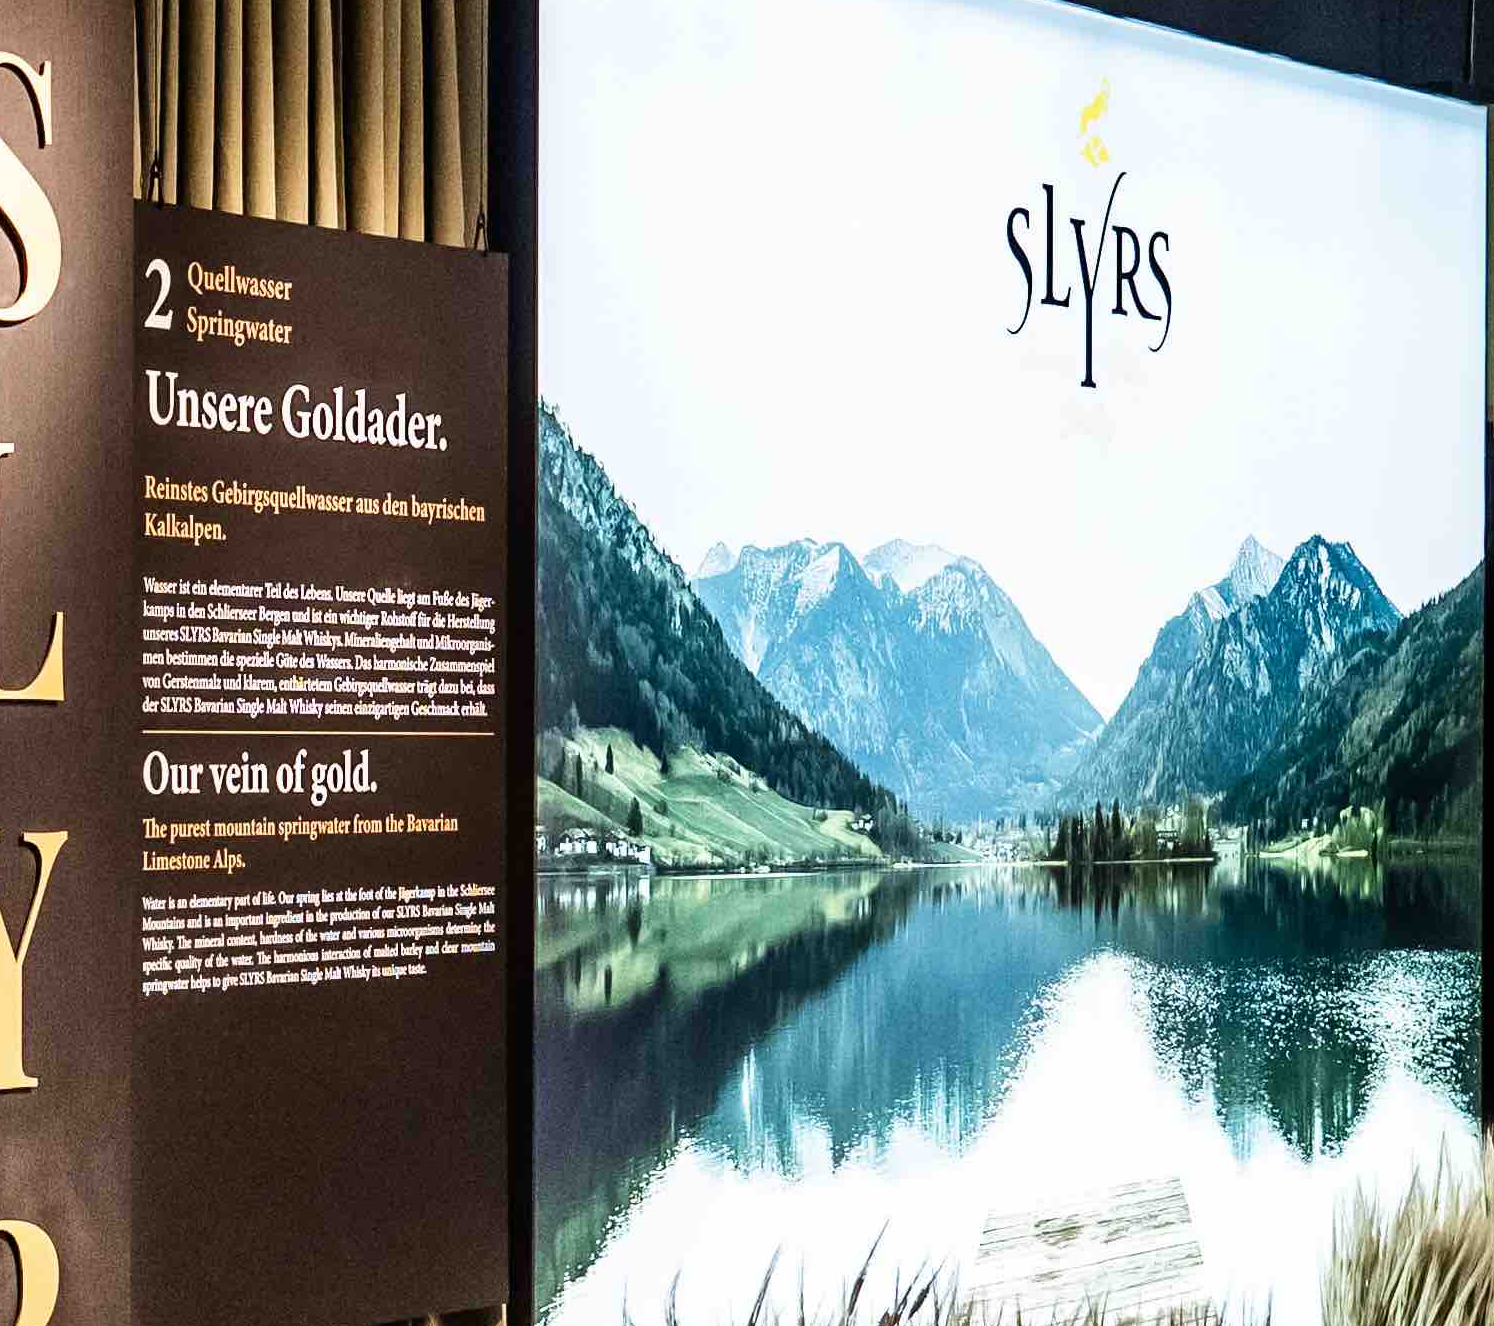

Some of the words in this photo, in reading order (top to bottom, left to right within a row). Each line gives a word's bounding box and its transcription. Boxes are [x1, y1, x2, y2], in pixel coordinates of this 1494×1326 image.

[145, 259, 173, 330] 2
[188, 261, 292, 301] Quellwasser
[1006, 171, 1172, 388] SLYRS
[187, 306, 292, 347] Springwater
[146, 369, 272, 435] Unsere
[282, 384, 447, 451] Goldader.
[145, 475, 208, 503] Reinstes
[212, 480, 353, 515] Gebirgsquellwasser
[356, 498, 379, 515] aus
[382, 492, 408, 517] den
[412, 494, 484, 526] bayrischen
[145, 512, 226, 546] Kalkalpen.
[143, 750, 203, 795] Our
[209, 751, 269, 795] vein
[276, 748, 307, 794] of
[311, 748, 377, 807] gold.
[143, 817, 167, 839] The
[170, 819, 211, 844] purest
[214, 816, 275, 837] mountain
[278, 815, 350, 841] springwater
[353, 814, 382, 834] from
[386, 813, 404, 833] the
[407, 813, 458, 833] Bavarian
[143, 851, 210, 871] Limestone
[213, 847, 245, 875] Alps.
